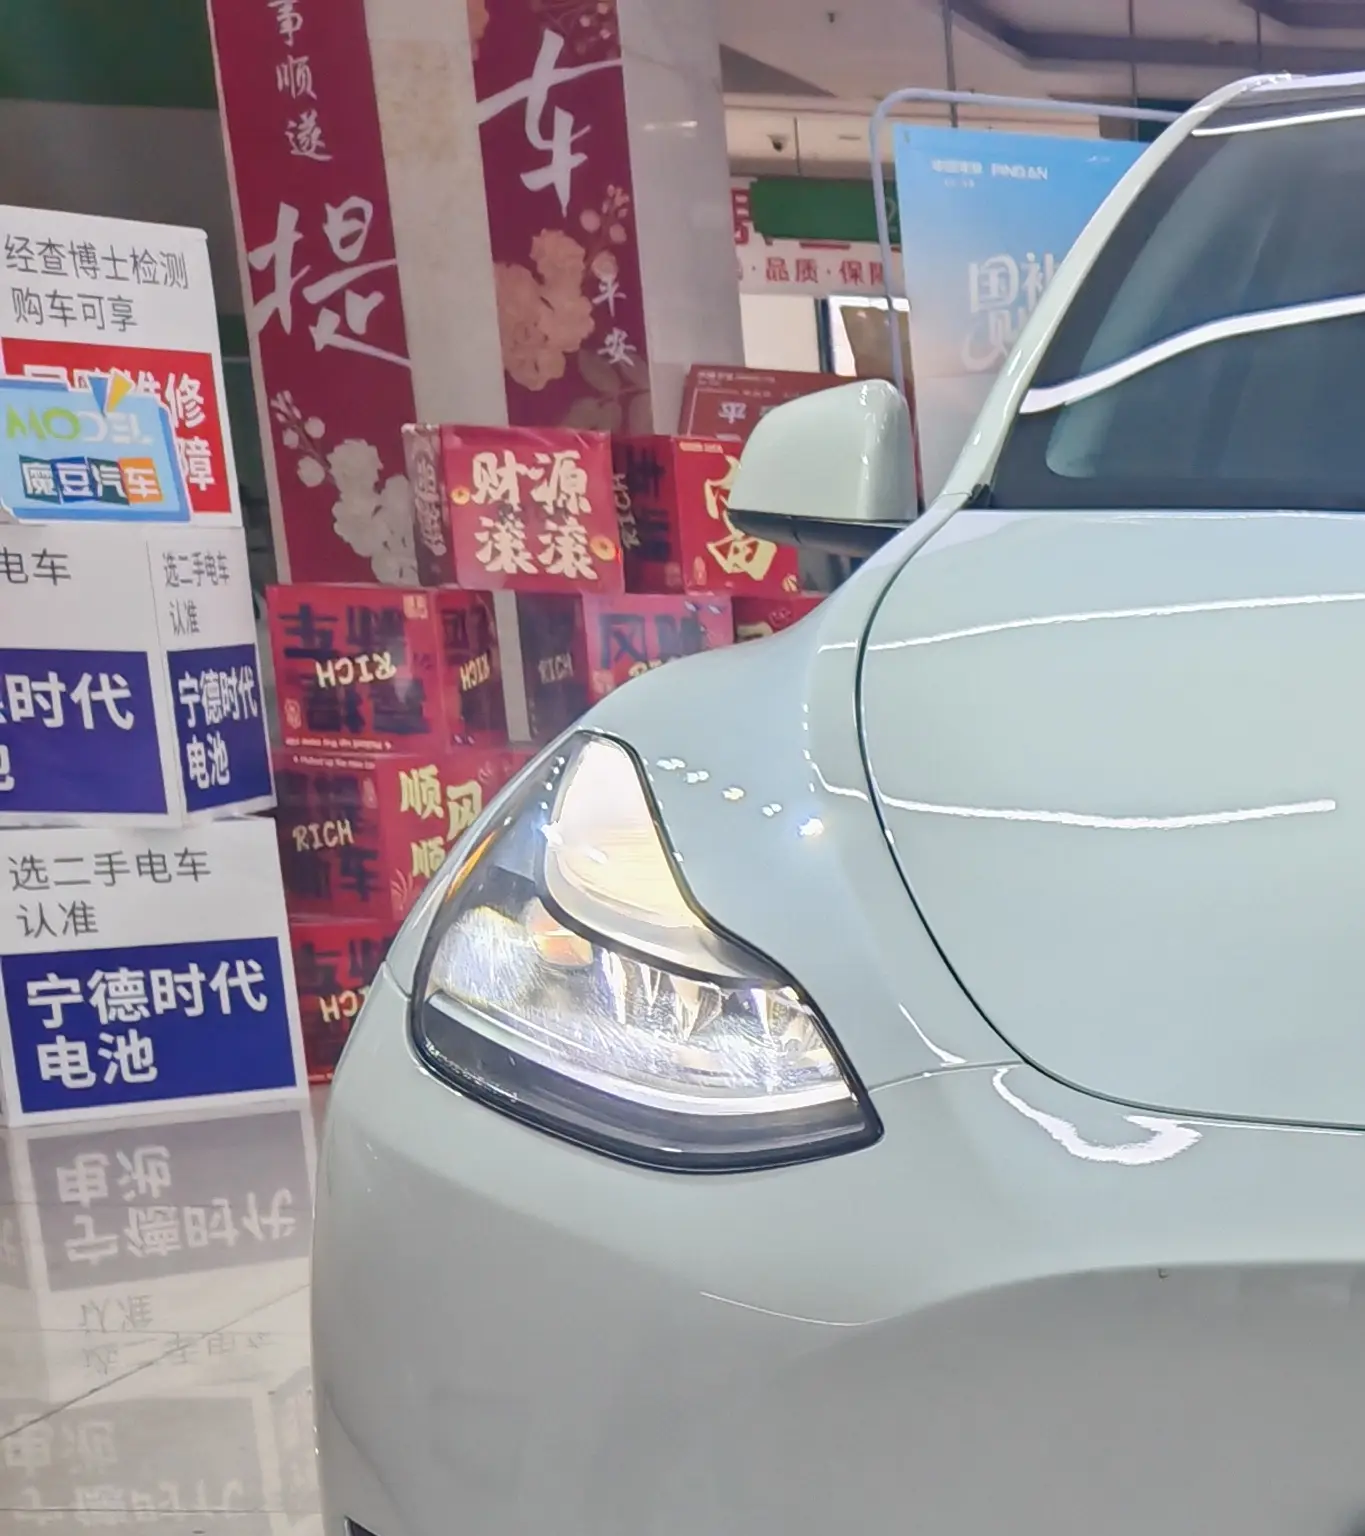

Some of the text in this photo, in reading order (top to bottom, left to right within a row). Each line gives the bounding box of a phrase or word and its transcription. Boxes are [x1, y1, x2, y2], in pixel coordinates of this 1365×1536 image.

[5, 234, 189, 290] 经查博士检测
[12, 286, 138, 331] 购车可享
[22, 460, 160, 499] 魔豆汽车
[471, 450, 591, 515] 财源
[163, 550, 230, 588] 选二手电车
[474, 516, 598, 580] 滚滚
[170, 600, 200, 636] 认准
[315, 651, 397, 688] RICH
[0, 671, 134, 730] 时代
[178, 665, 258, 728] 宁德时代
[186, 731, 230, 789] 电池
[292, 819, 354, 852] RICH
[8, 847, 211, 891] 选二手电车
[16, 900, 99, 938] 认准
[26, 959, 268, 1029] 宁德时代
[37, 1028, 158, 1089] 电池
